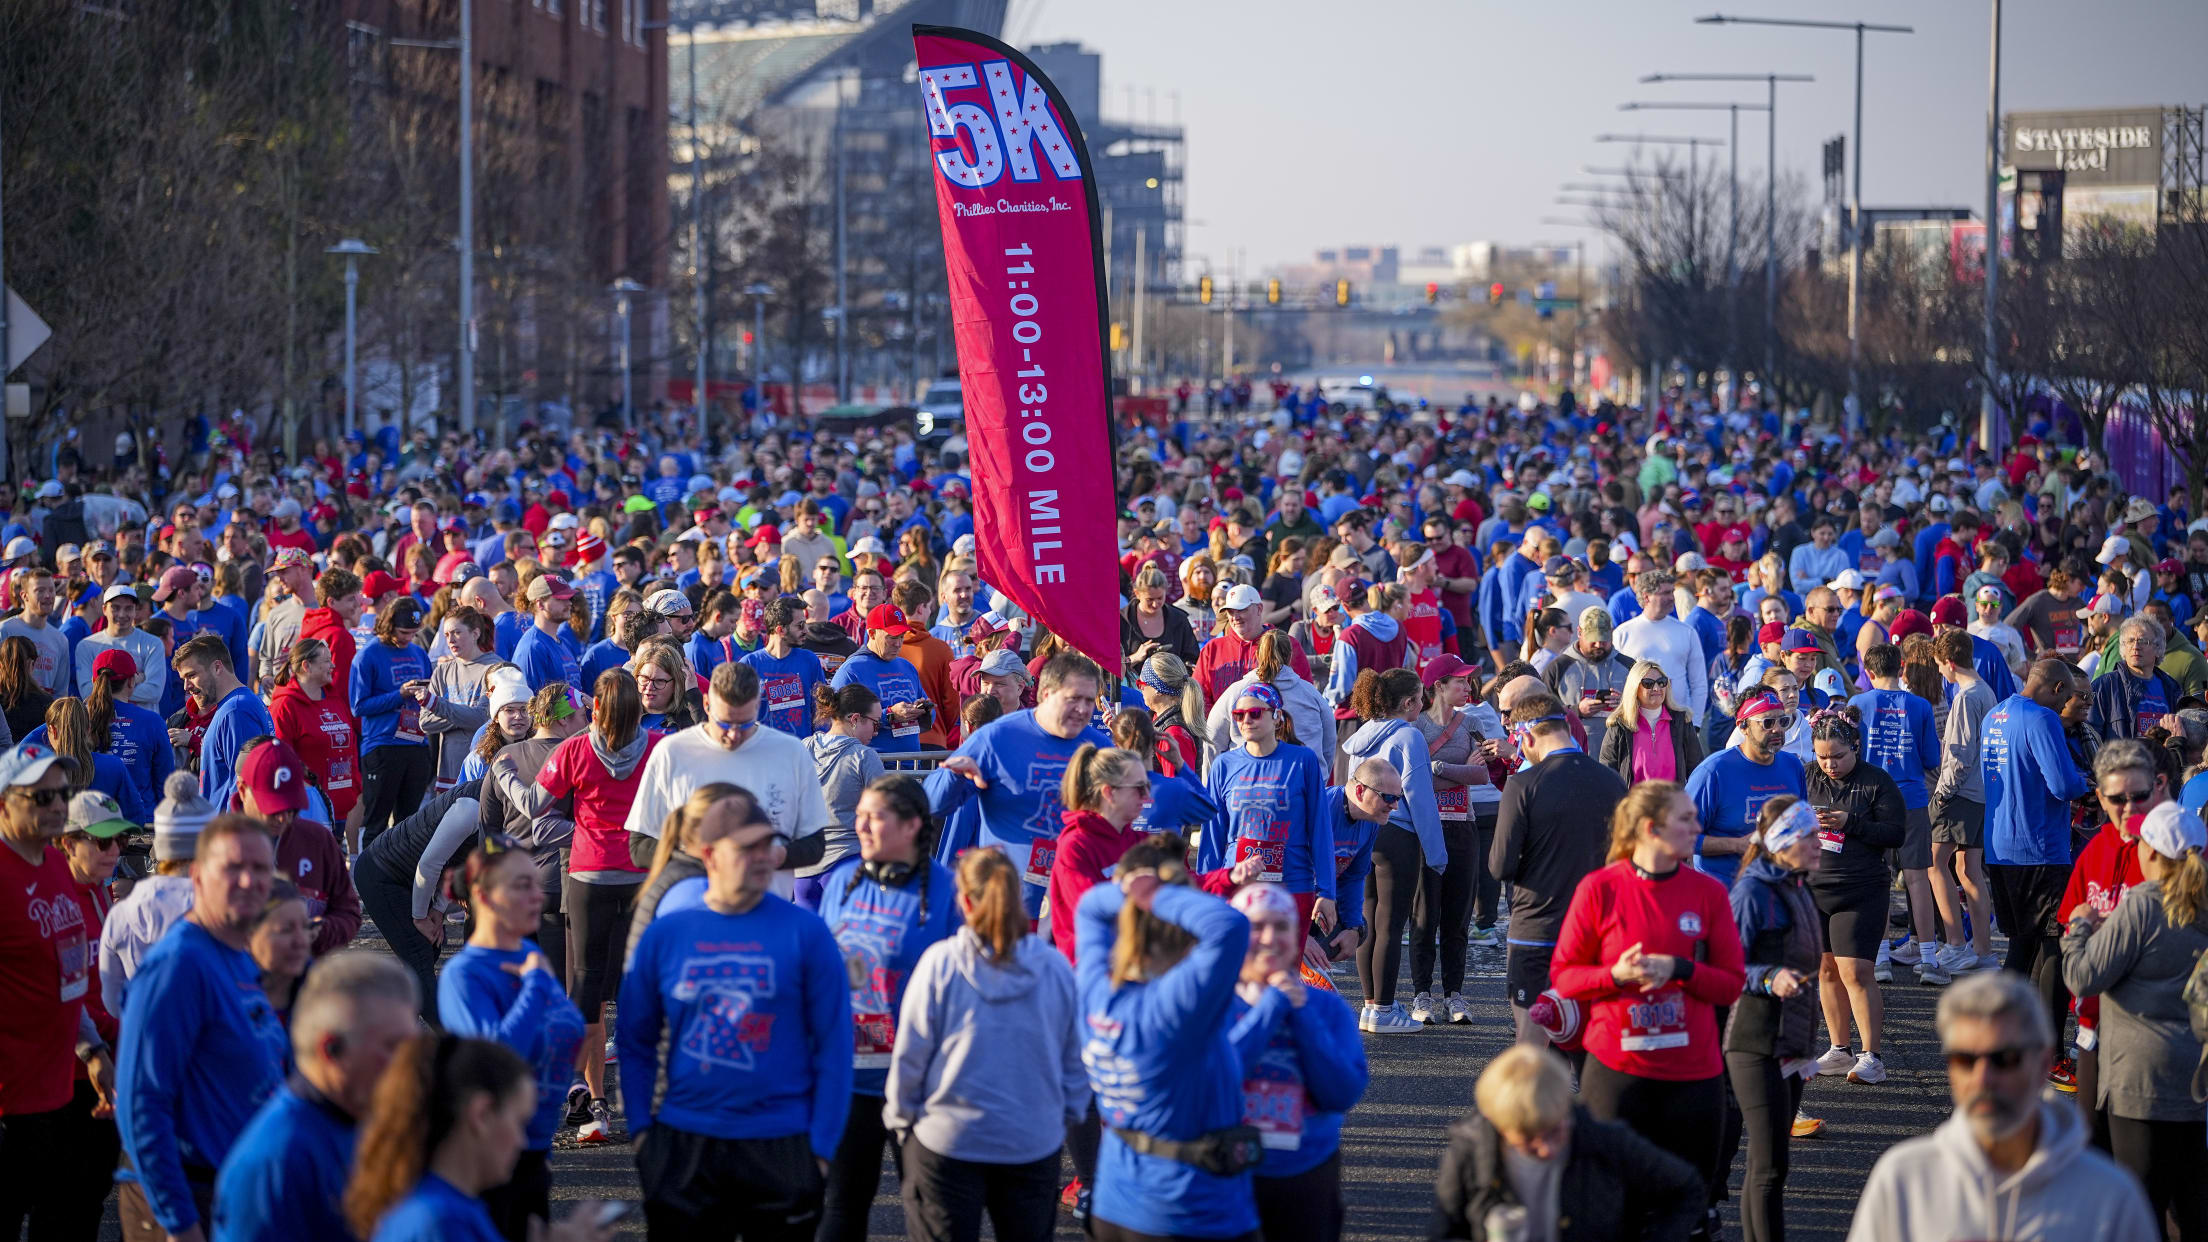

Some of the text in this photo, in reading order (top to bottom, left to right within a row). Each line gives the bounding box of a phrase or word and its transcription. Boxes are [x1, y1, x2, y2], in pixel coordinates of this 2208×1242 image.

[919, 58, 1083, 189] 5K
[2015, 126, 2151, 151] STATESIDE
[954, 196, 1072, 217] Phillies Charities, Inc.
[1005, 242, 1066, 585] 11:00-13:00 MILE
[768, 682, 800, 700] 5089
[274, 766, 292, 790] P
[1269, 820, 1291, 841] 5K
[298, 858, 313, 877] P
[1627, 1002, 1678, 1028] 1819
